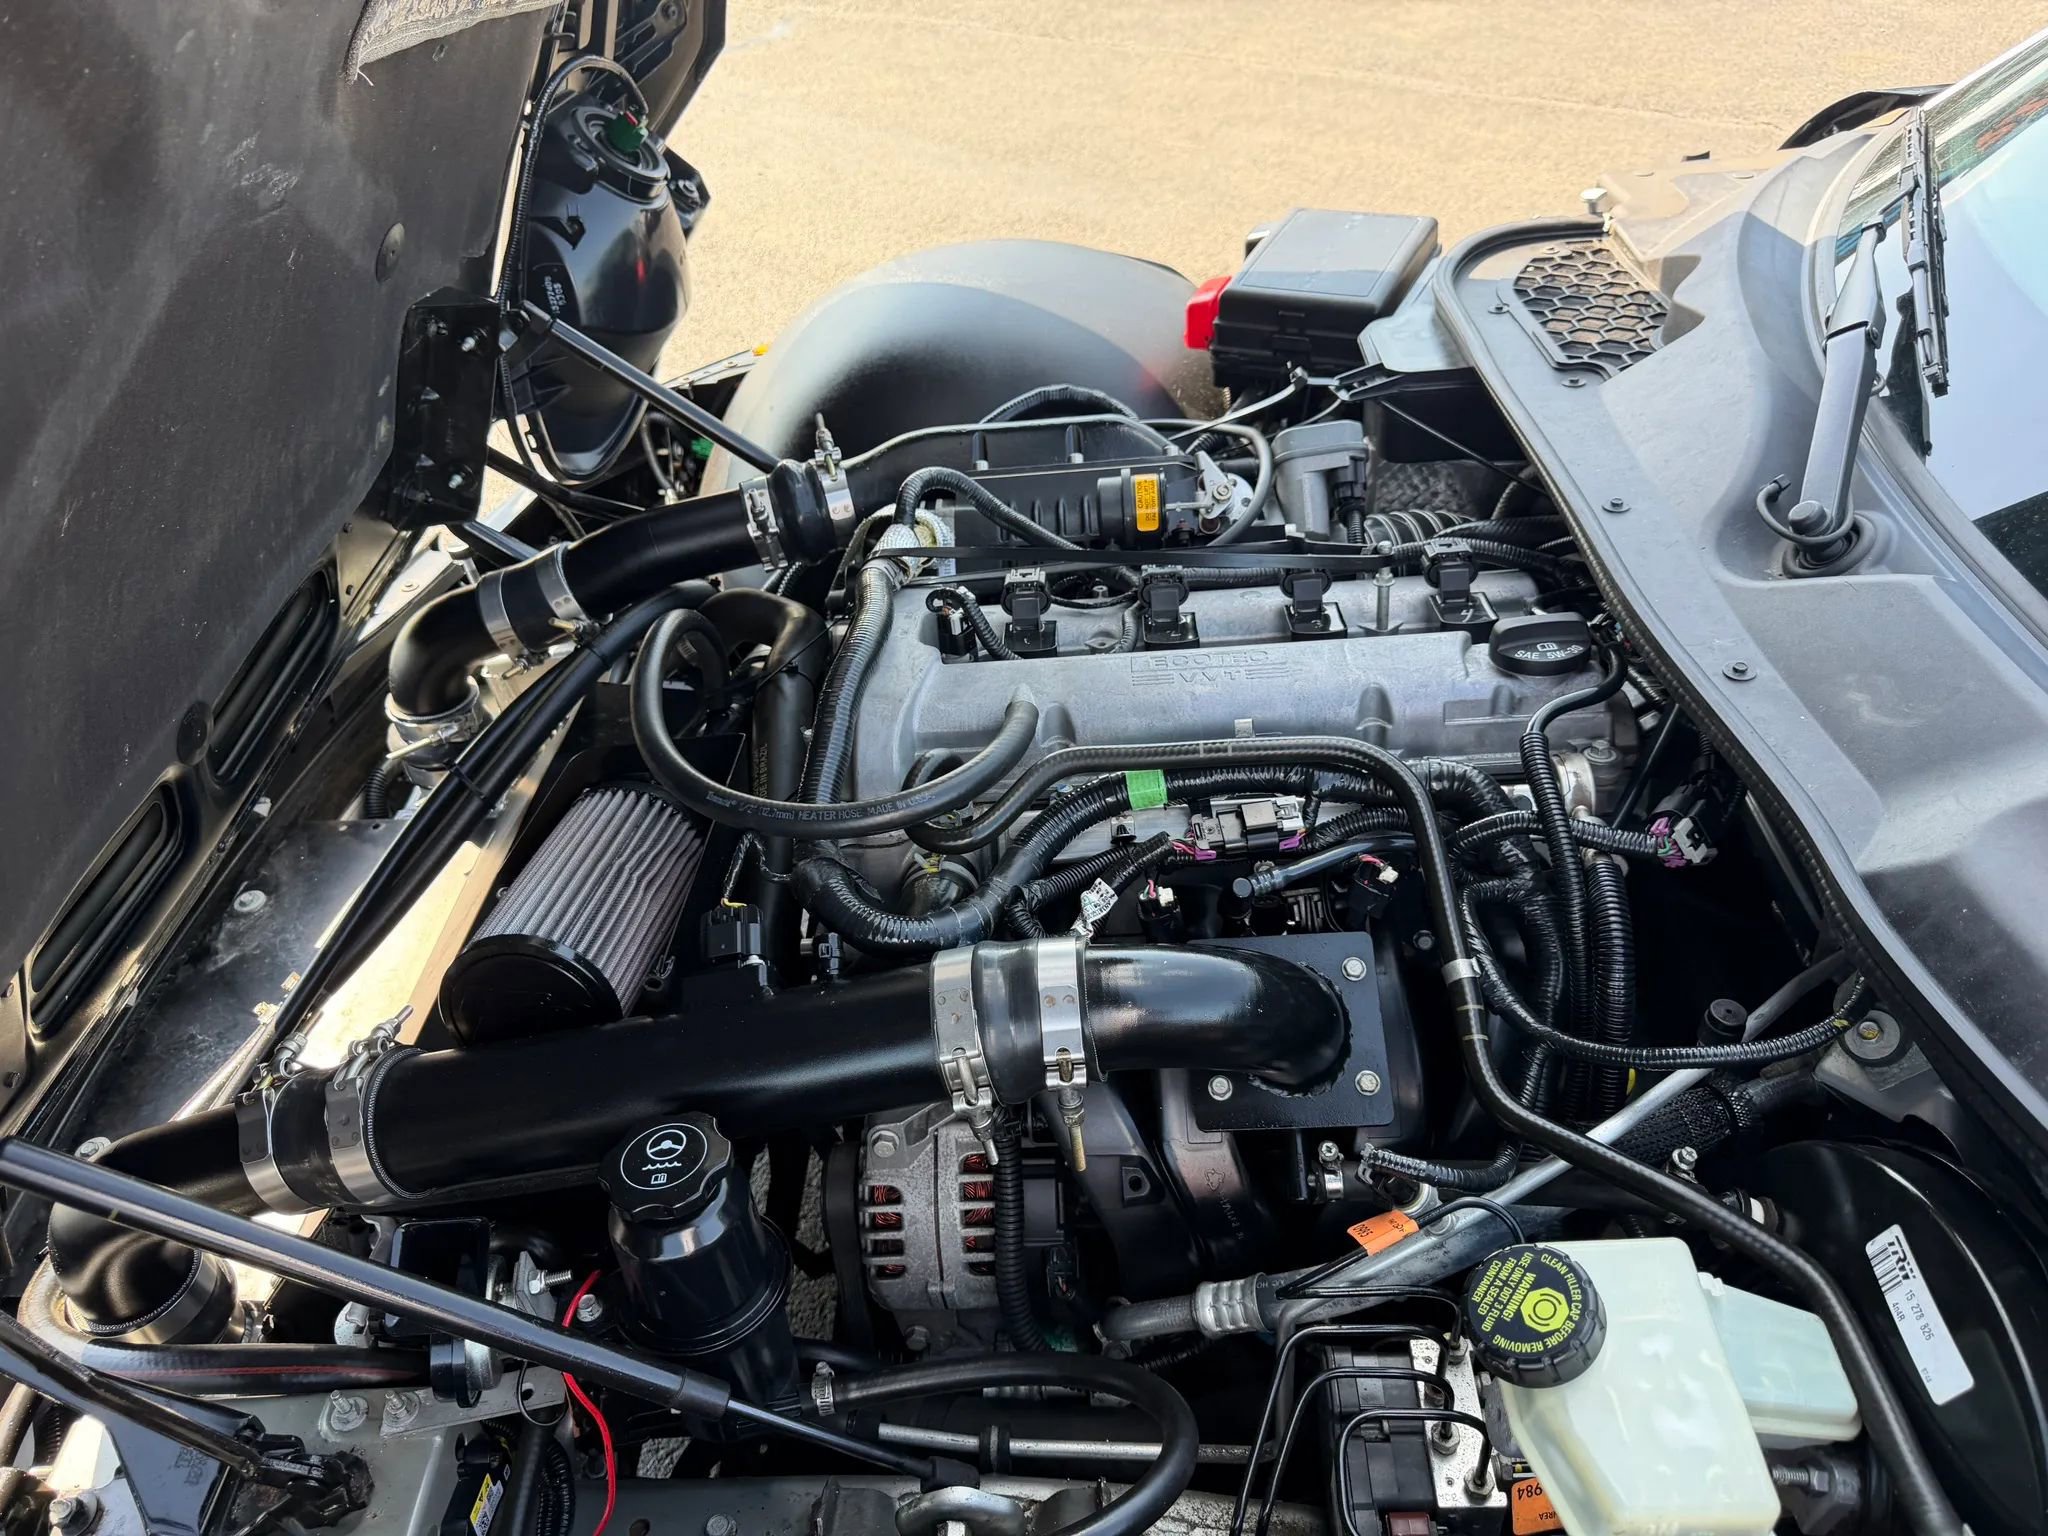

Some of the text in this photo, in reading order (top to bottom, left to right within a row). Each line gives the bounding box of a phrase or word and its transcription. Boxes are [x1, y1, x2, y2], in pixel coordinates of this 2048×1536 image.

[1154, 650, 1269, 668] ECOTEC
[1514, 644, 1584, 659] SAE 5W-30
[1178, 670, 1241, 683] VVT
[799, 810, 836, 821] HEATER
[838, 808, 863, 819] HOSE
[867, 803, 894, 816] MADE
[897, 800, 906, 810] IN
[1499, 1257, 1517, 1281] FROM
[1518, 1252, 1534, 1268] USE
[1887, 1235, 1916, 1281] TRW
[1471, 1260, 1502, 1303] CONTAINER
[1507, 1265, 1525, 1288] ONLY
[1477, 1285, 1500, 1315] SEALED
[1492, 1253, 1582, 1353] CLEAN FILLER CAP BEFORE REMOVING
[1498, 1286, 1513, 1304] DOT
[1502, 1272, 1537, 1322] WARNING!
[1481, 1308, 1500, 1332] FLUID
[1904, 1289, 1935, 1341] 15 278 826
